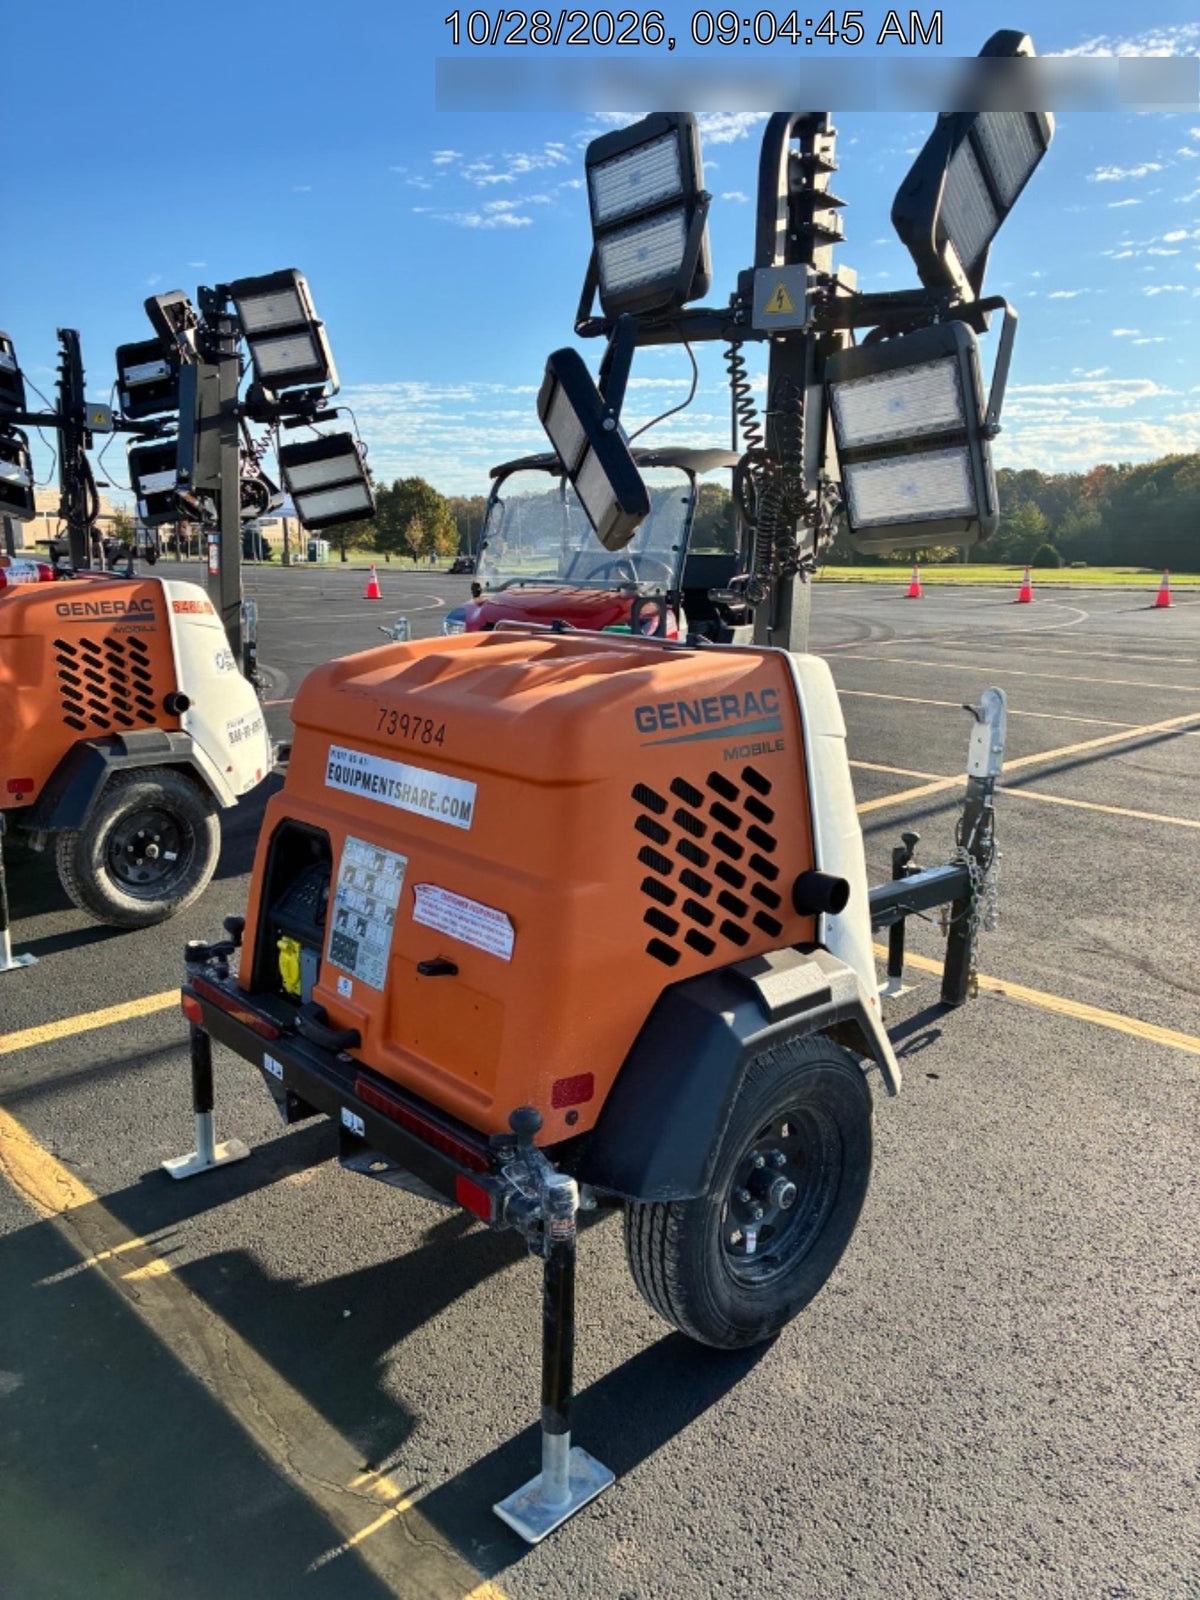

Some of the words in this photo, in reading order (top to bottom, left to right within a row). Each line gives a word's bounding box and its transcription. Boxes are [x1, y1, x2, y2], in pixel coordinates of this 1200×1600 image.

[56, 599, 154, 616] GENERAC
[376, 708, 446, 747] 739784
[635, 689, 779, 733] GENERAC
[723, 738, 785, 761] MOBILE
[327, 762, 472, 822] EQUIPMENTSHARE.COM
